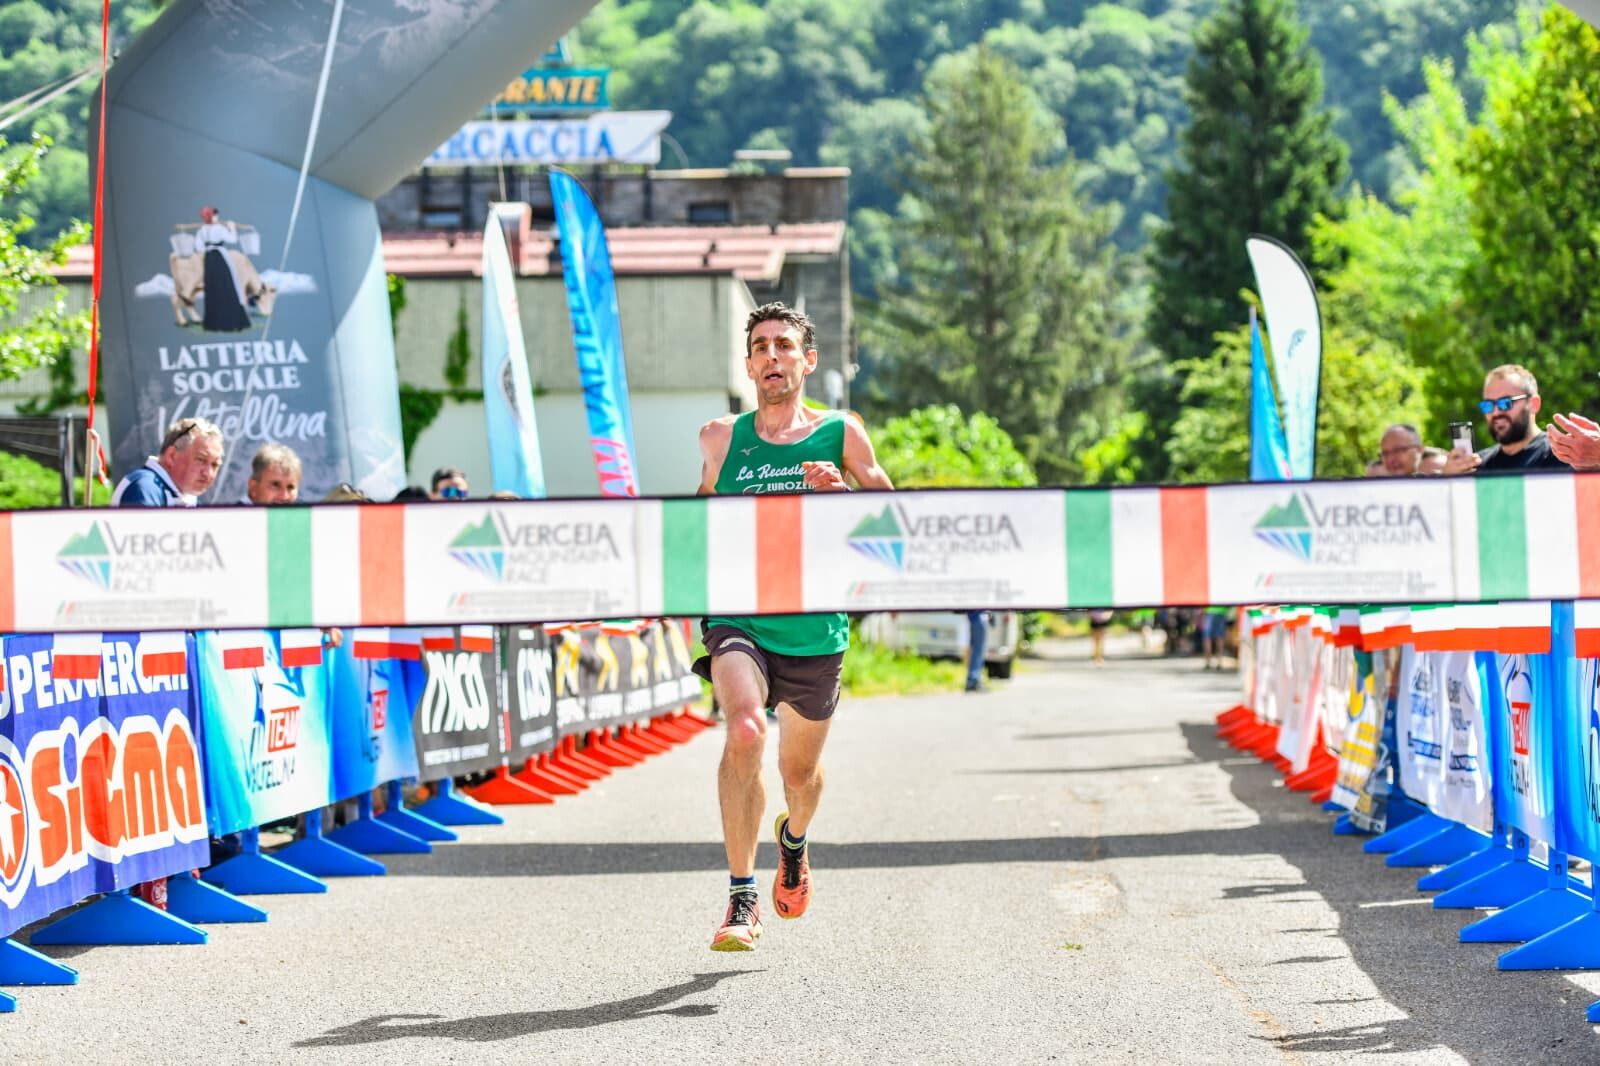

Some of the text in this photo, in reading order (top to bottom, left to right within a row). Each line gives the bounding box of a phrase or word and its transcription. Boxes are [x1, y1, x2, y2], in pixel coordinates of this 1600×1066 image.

[158, 339, 308, 371] LATTERIA
[172, 366, 301, 395] SOCIALE
[736, 466, 755, 482] La
[496, 508, 622, 560] VERCEIA
[896, 500, 1024, 551] VERCEIA
[1303, 489, 1435, 542] VERCEIA
[103, 519, 226, 570] VERCEIA
